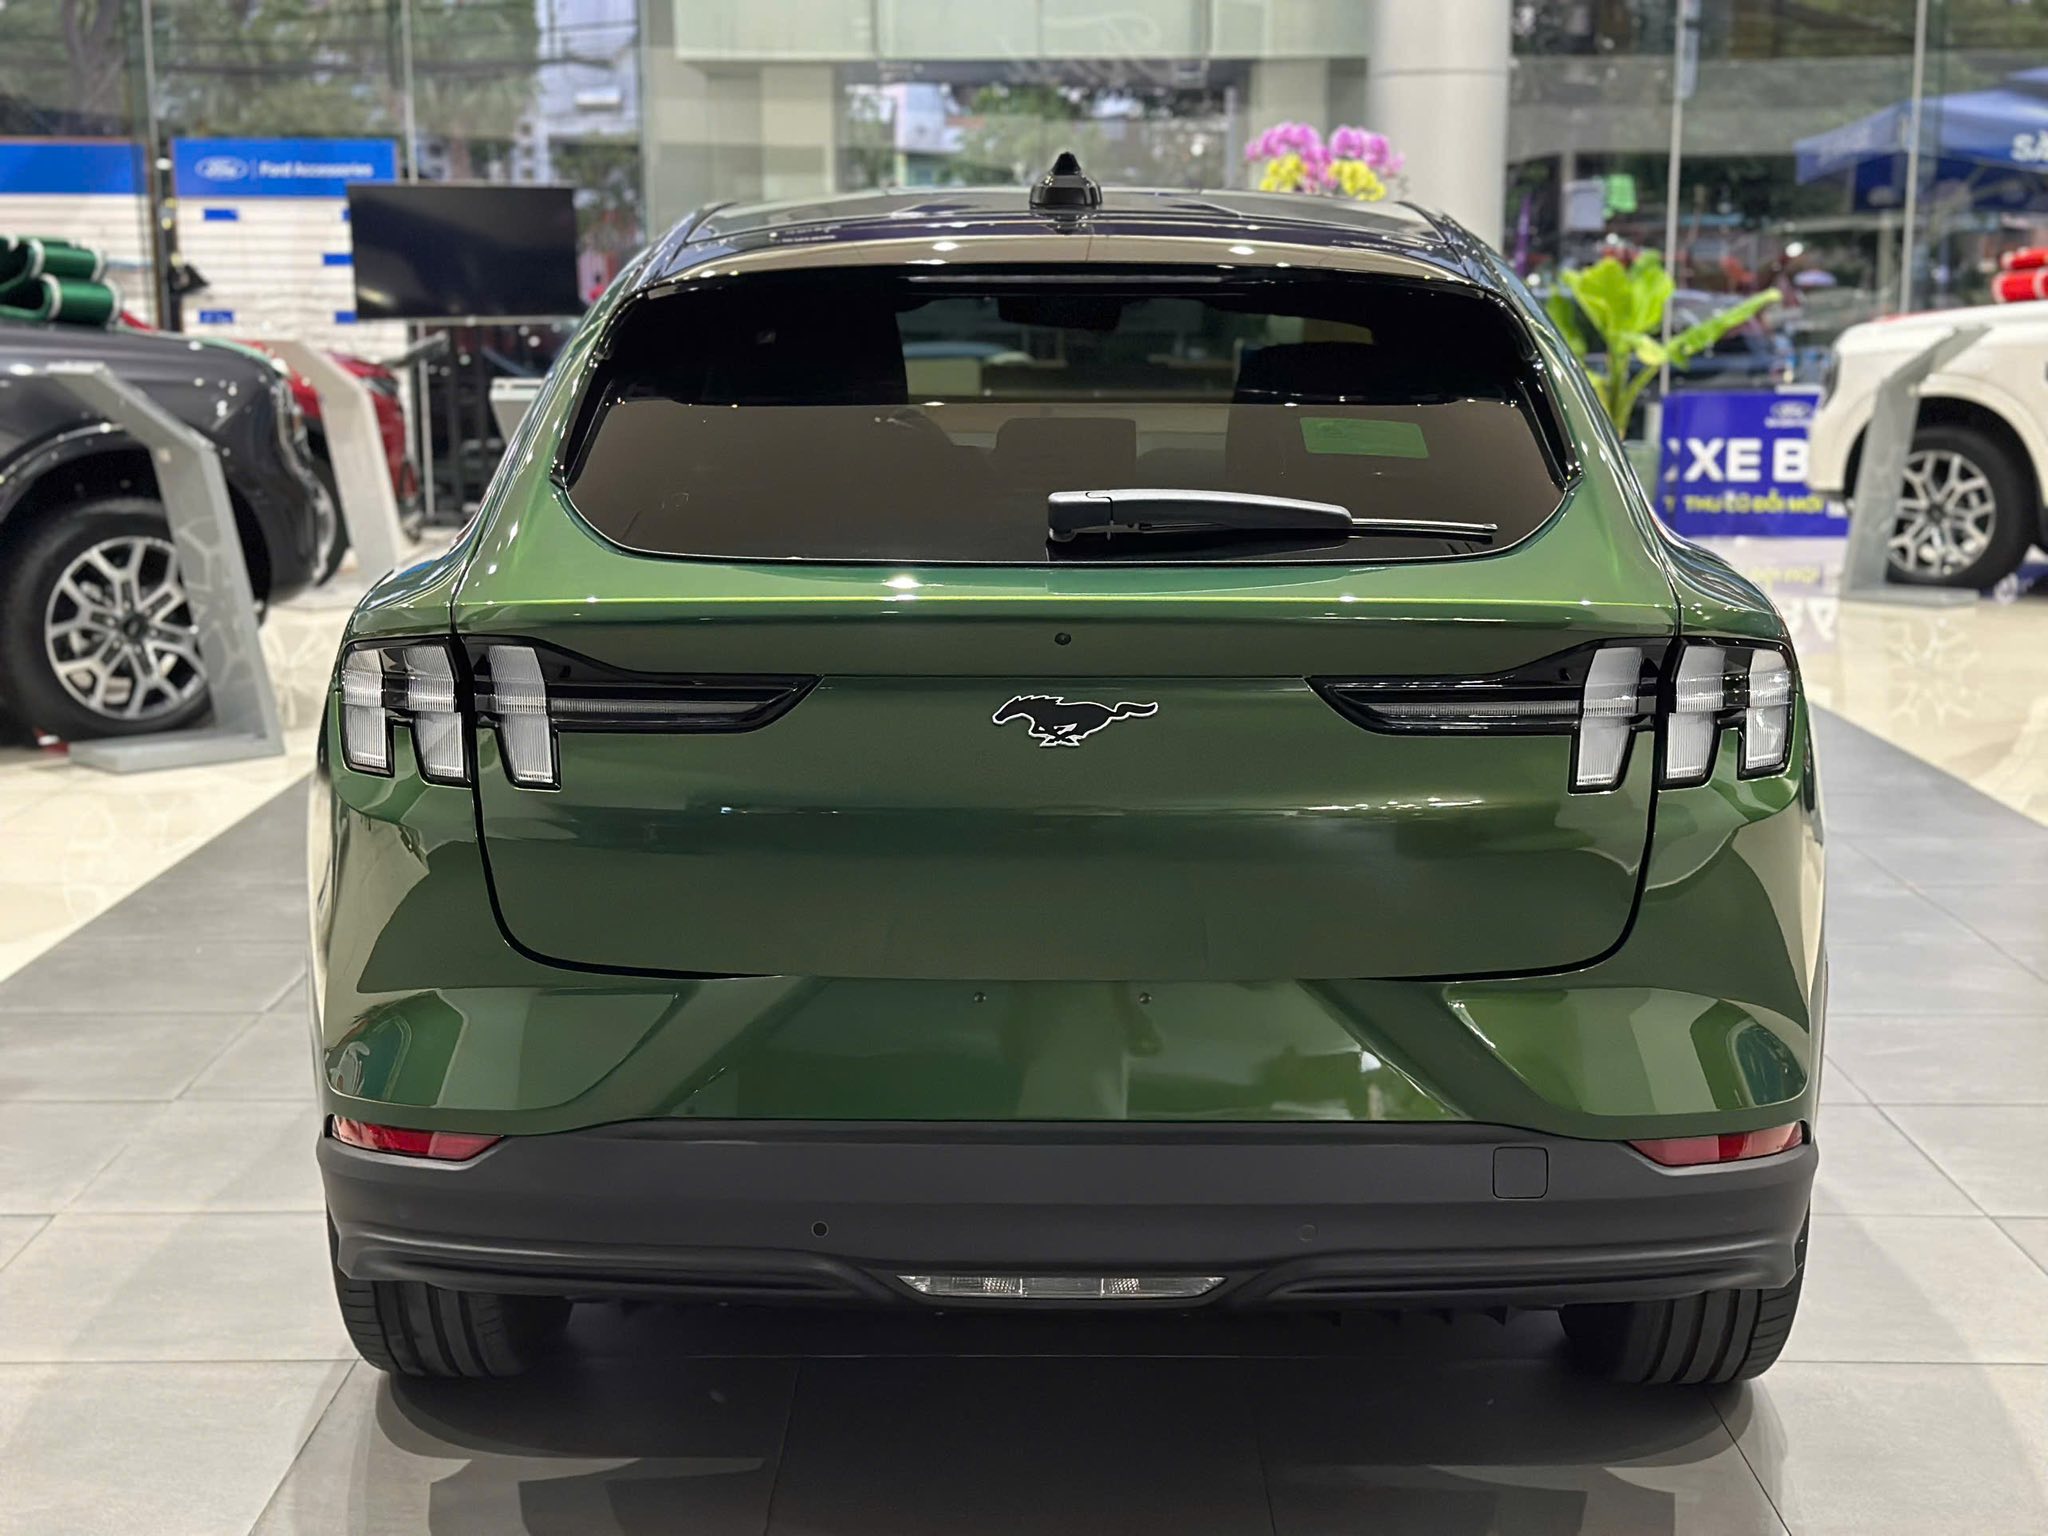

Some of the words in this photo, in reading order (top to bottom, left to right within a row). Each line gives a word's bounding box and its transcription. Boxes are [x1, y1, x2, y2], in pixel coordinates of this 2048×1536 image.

[259, 161, 293, 179] Ford
[295, 161, 374, 179] Accessories
[1683, 436, 1763, 483] XE
